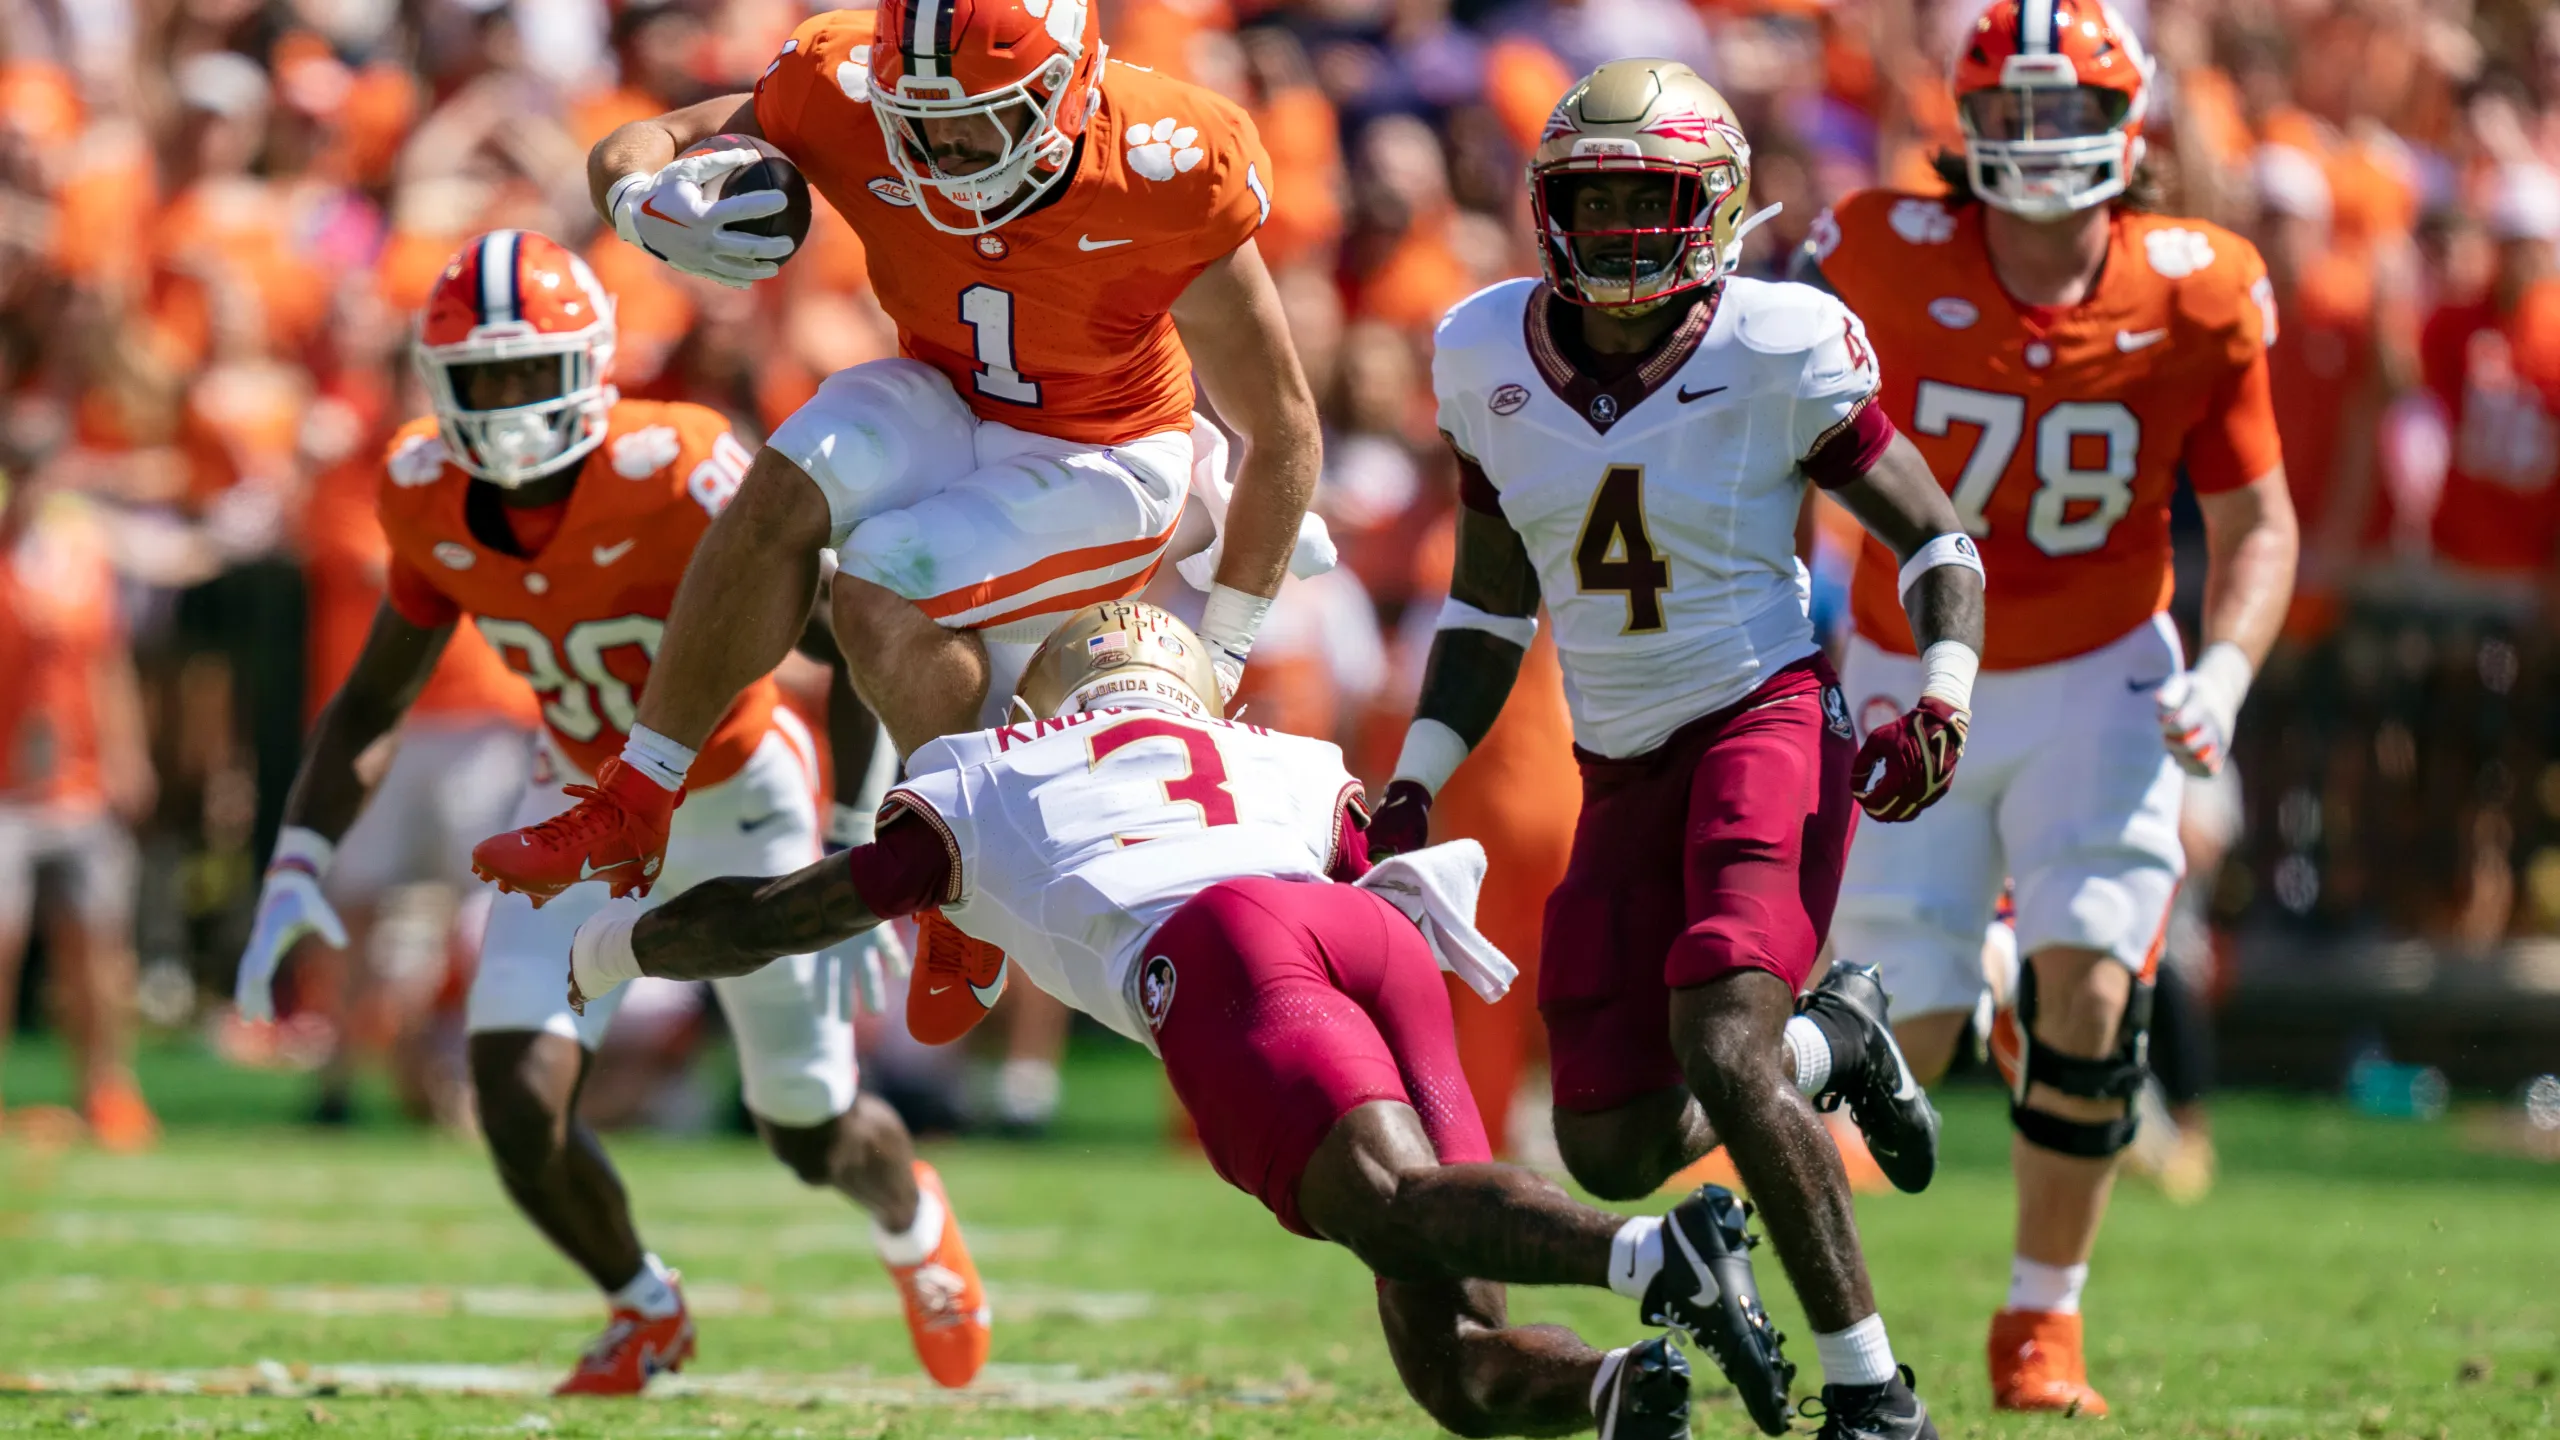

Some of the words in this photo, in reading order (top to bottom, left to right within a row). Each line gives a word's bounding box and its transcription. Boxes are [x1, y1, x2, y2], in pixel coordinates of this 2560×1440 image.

[904, 87, 951, 101] TIGERS
[874, 182, 913, 203] ACC
[958, 282, 1043, 409] 1
[1842, 315, 1872, 374] 4
[1914, 378, 2141, 558] 78
[1570, 463, 1673, 637] 4
[1096, 653, 1125, 666] ACC
[1075, 679, 1149, 711] FLORIDA
[1156, 681, 1201, 715] STATE
[1084, 716, 1240, 849] 3
